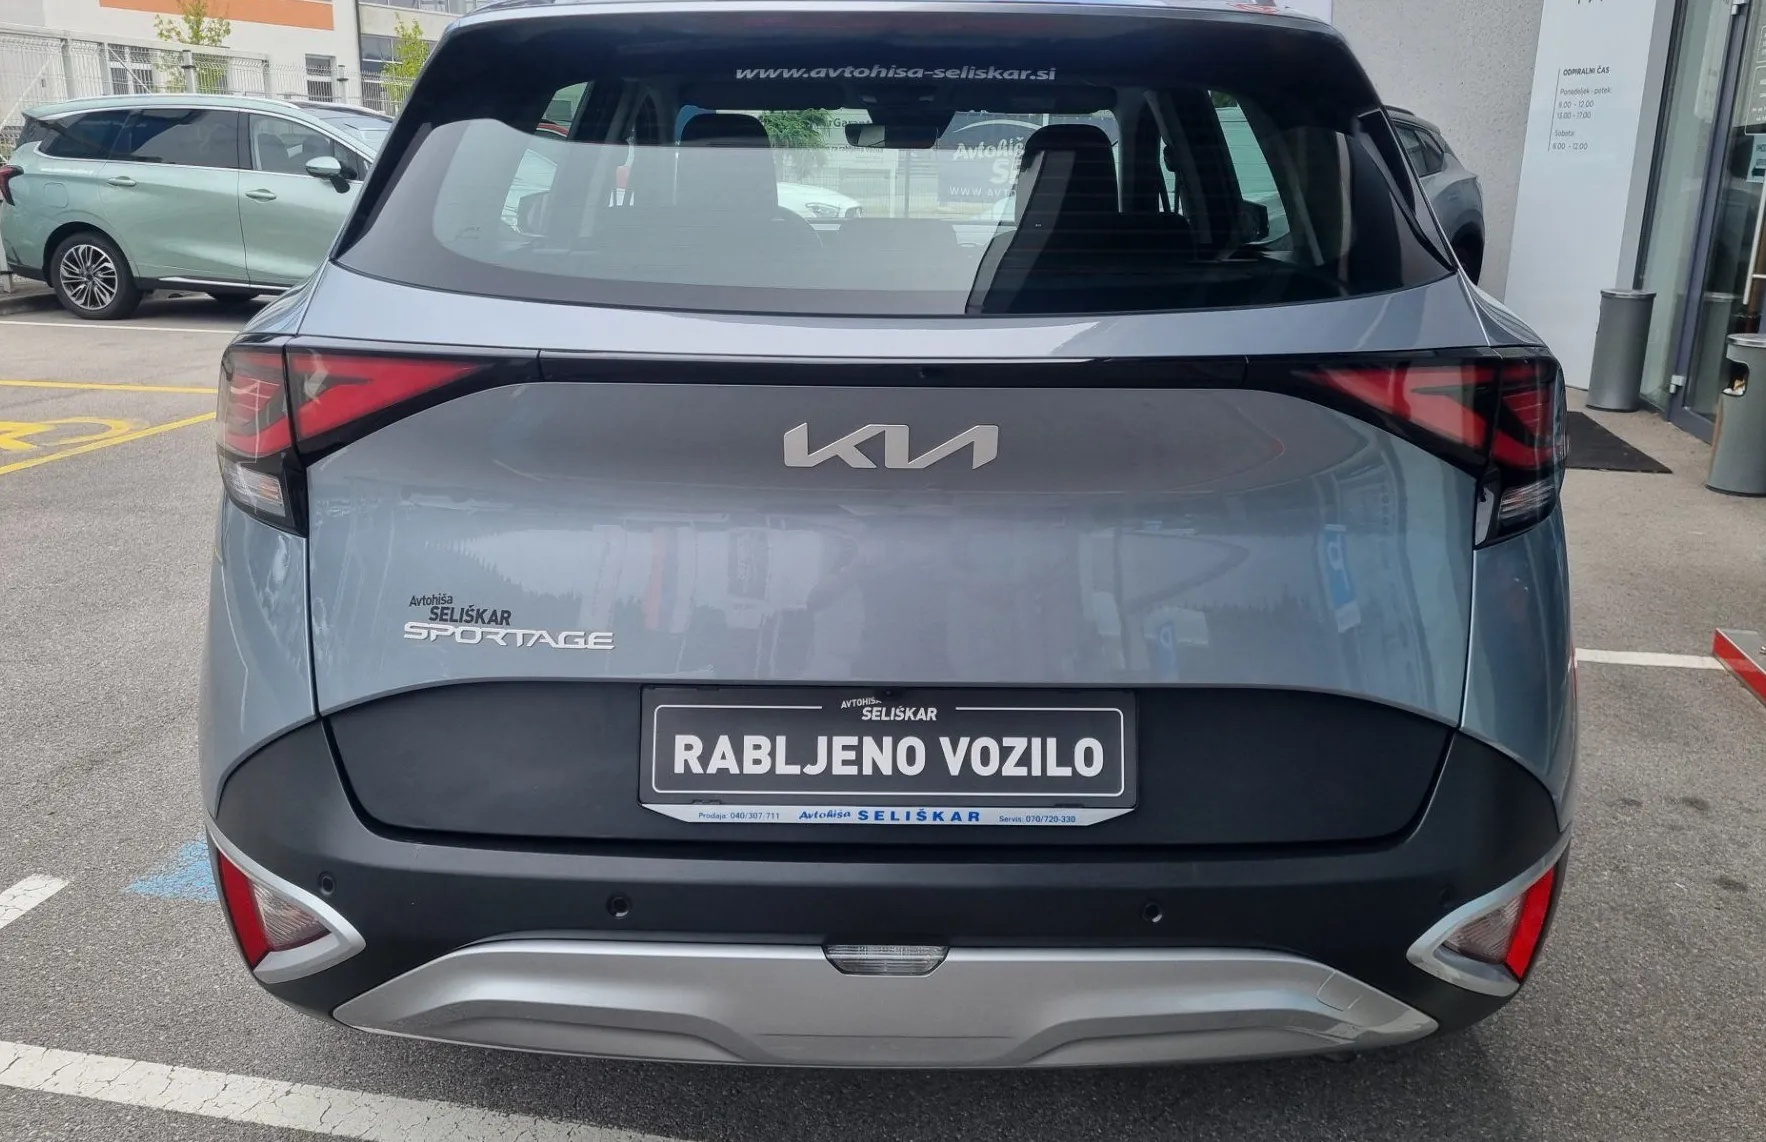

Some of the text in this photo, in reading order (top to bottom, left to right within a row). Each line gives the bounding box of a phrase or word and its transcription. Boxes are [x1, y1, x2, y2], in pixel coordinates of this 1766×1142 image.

[736, 64, 1056, 81] www.avtohisa-seliskar.si
[953, 136, 1025, 160] Avtohiš
[784, 422, 999, 469] KIA
[409, 593, 453, 607] Avtohiša
[404, 621, 615, 650] SPORTAGE
[673, 734, 1104, 777] RABLJENO VOZILO
[858, 808, 980, 822] SELIŠKAR
